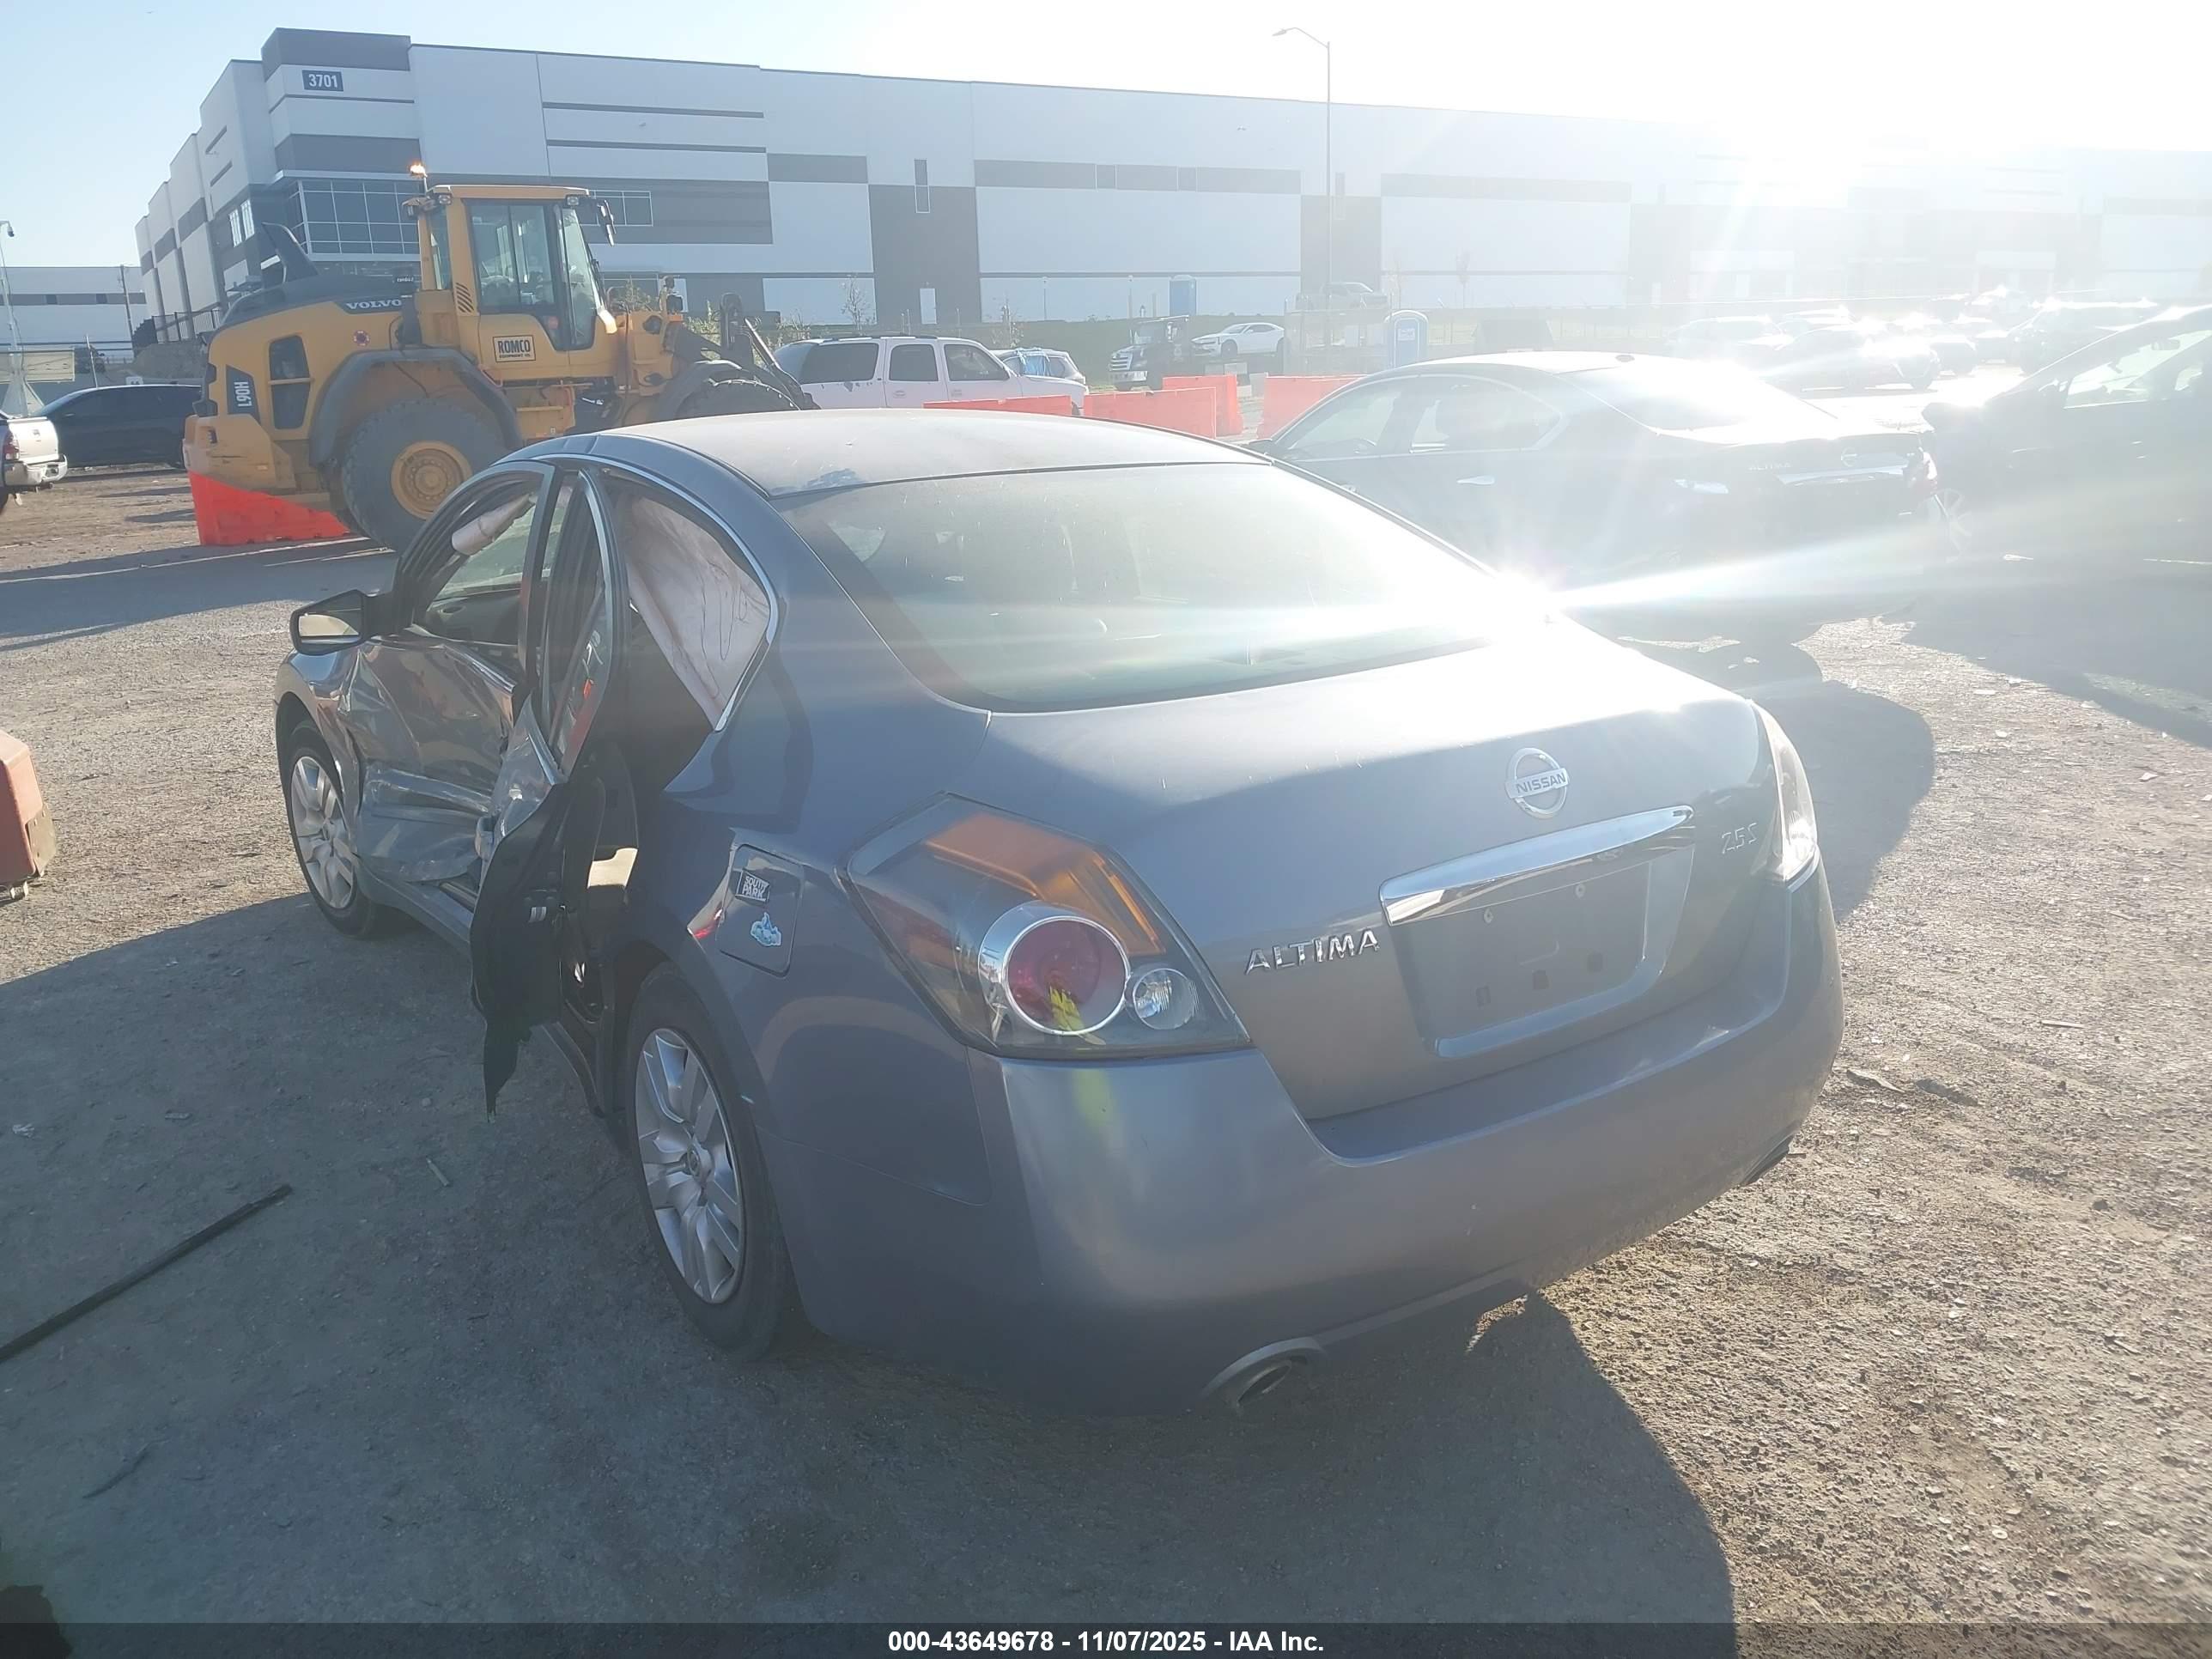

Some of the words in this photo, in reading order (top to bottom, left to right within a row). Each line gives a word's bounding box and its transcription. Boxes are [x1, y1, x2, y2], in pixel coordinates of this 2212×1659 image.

[308, 73, 338, 88] 3701
[345, 298, 402, 310] VOLVO
[497, 339, 531, 354] ROMCO
[233, 381, 252, 407] L90H
[1515, 771, 1566, 793] NISSAN
[742, 883, 765, 900] PARK
[1244, 929, 1380, 975] ALTIMA
